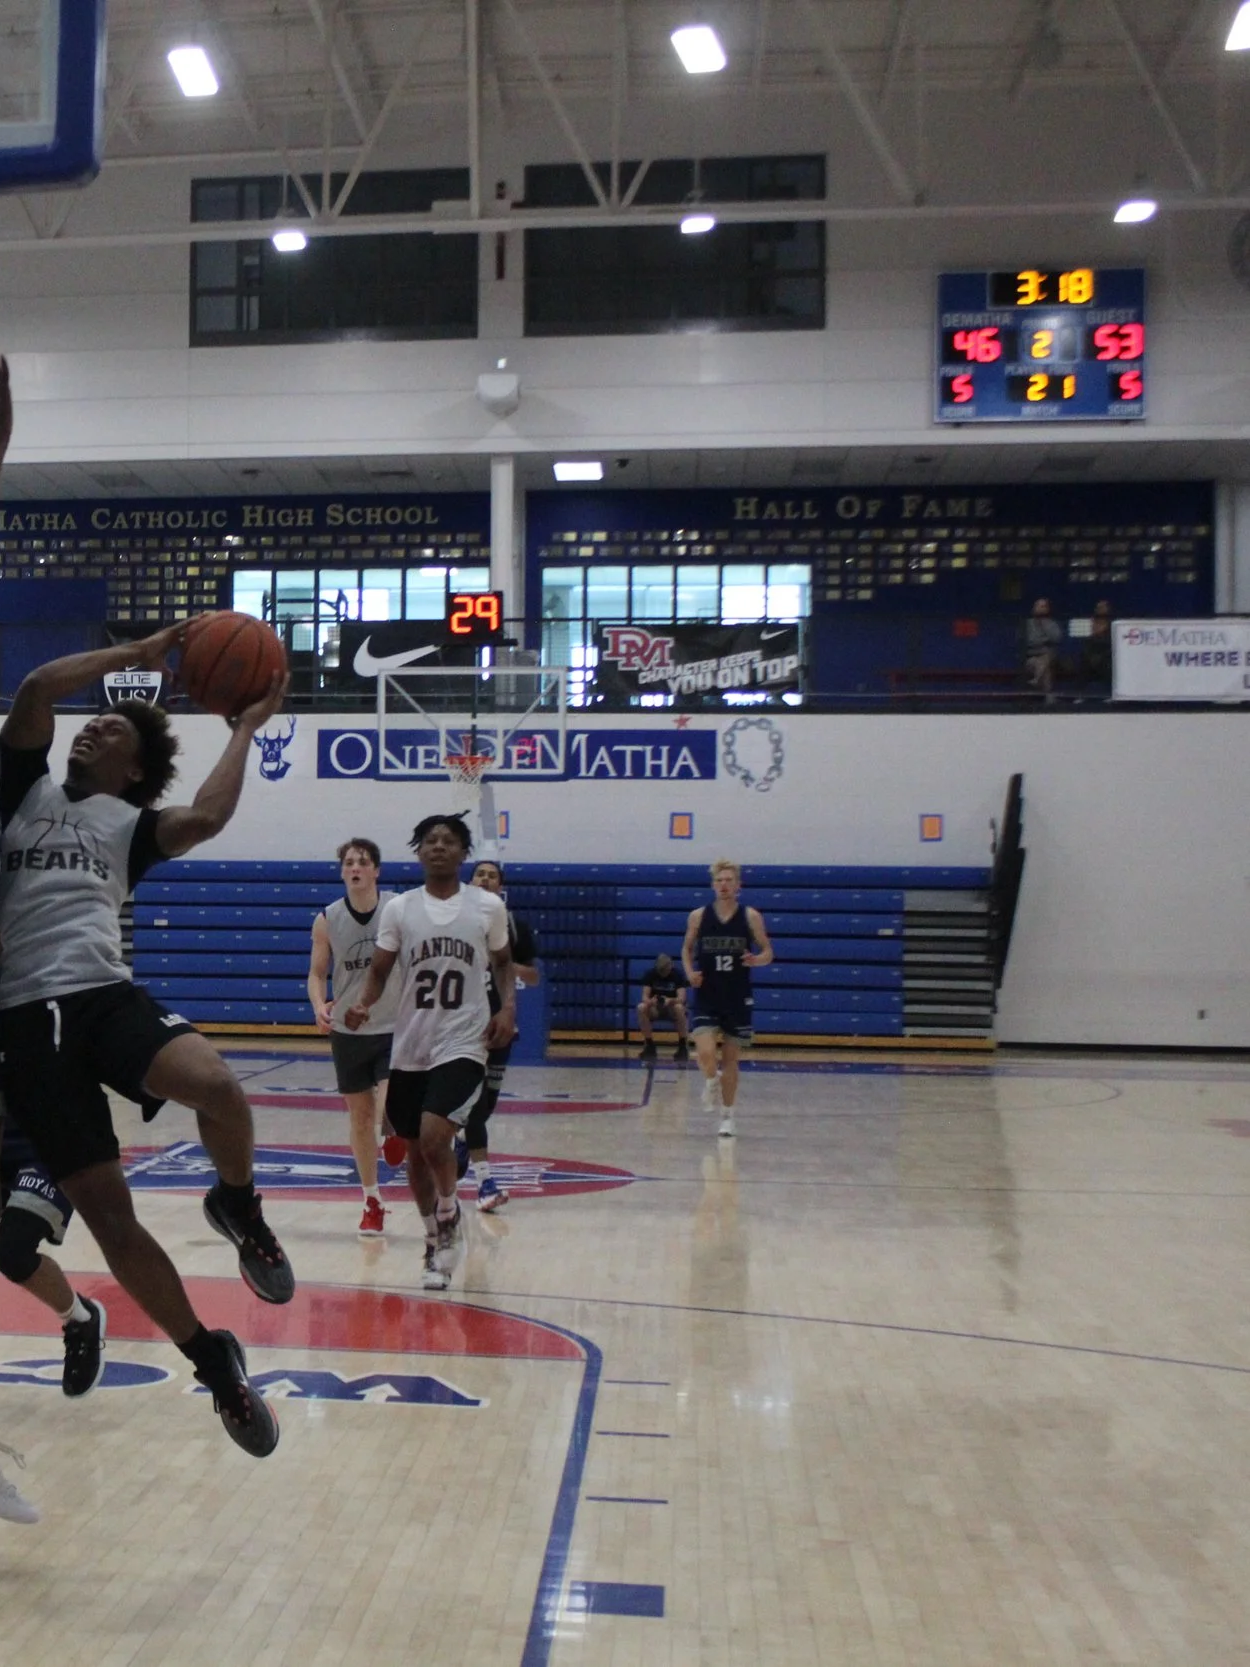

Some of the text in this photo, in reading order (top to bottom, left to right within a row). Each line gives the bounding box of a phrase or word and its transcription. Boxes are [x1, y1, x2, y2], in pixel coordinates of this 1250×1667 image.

[953, 327, 1002, 362] 46
[1031, 330, 1054, 358] 2
[1094, 323, 1145, 360] 53
[952, 374, 974, 402] 5
[1119, 370, 1144, 399] 5
[91, 508, 227, 530] CATHOLIC
[242, 505, 314, 527] HIGH
[326, 503, 439, 525] SCHOOL
[734, 495, 994, 519] HALL OF FAME
[451, 596, 498, 633] 29
[639, 658, 717, 684] CHARACTER
[1165, 651, 1239, 667] WHERE
[667, 654, 799, 695] YOU ON TOP
[6, 847, 110, 882] BEARS
[344, 956, 373, 972] BEA
[410, 937, 475, 968] LANDON
[715, 955, 734, 971] 12
[415, 970, 465, 1010] 20
[18, 1175, 57, 1200] HOYAS
